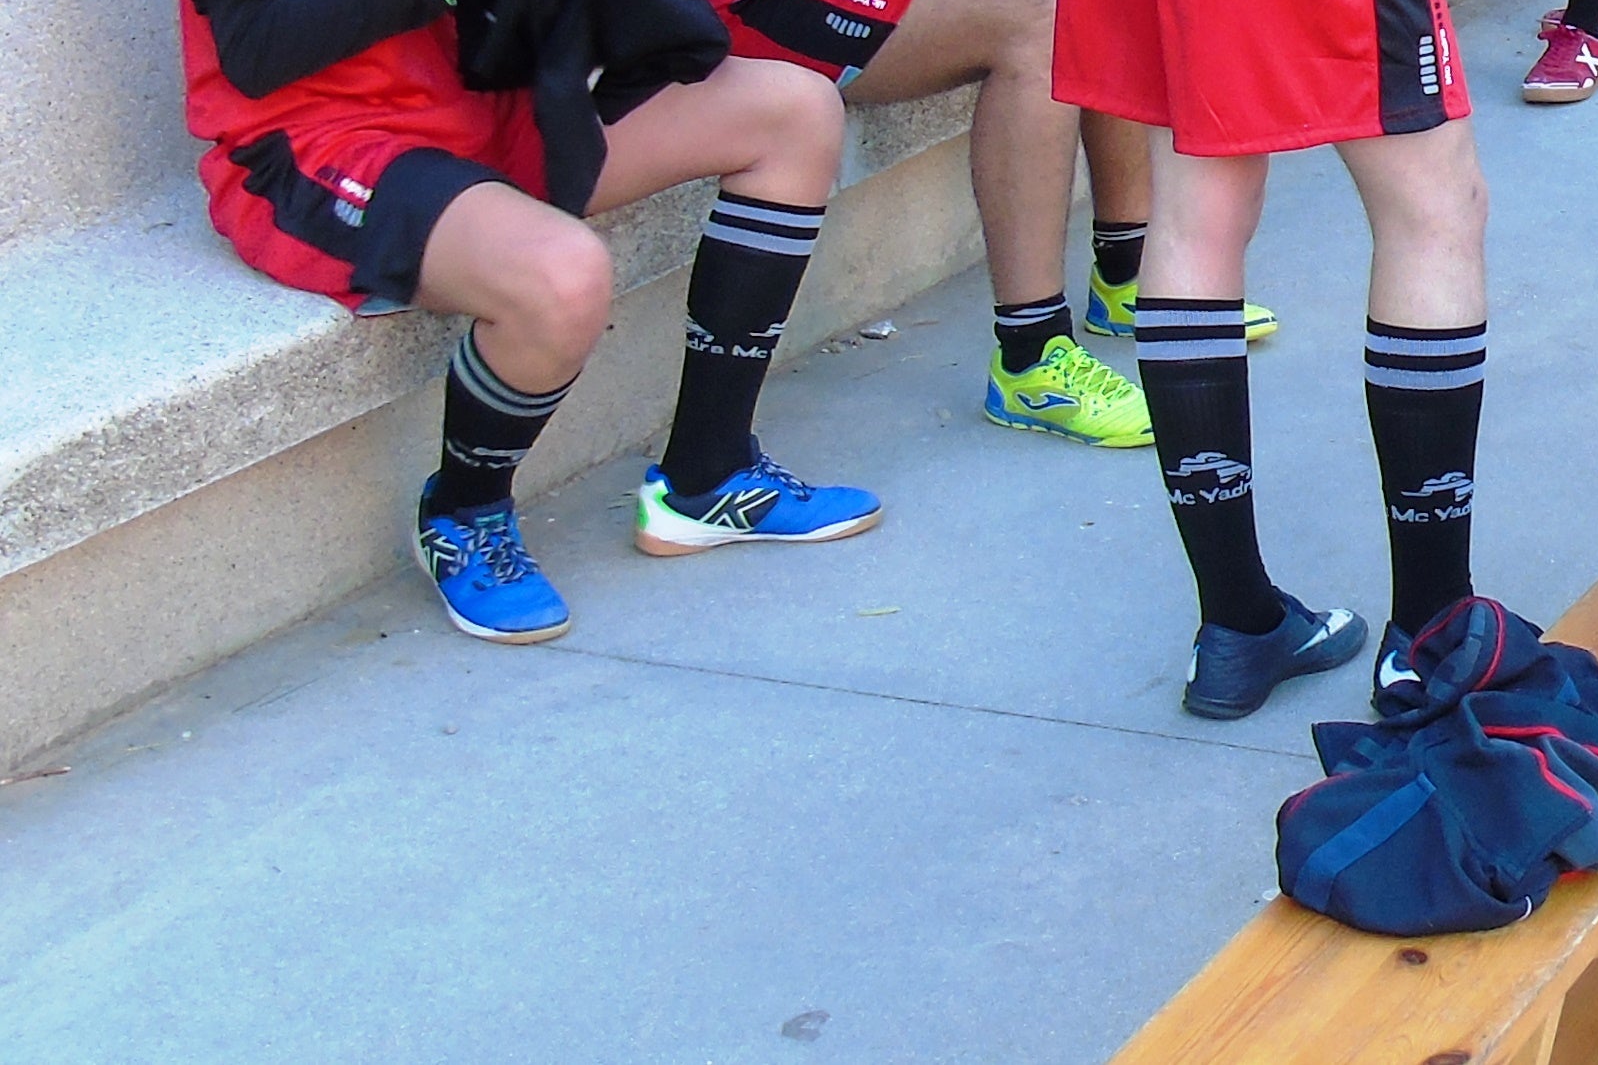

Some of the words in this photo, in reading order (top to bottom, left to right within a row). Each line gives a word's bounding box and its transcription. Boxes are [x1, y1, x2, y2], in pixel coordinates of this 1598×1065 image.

[1198, 479, 1254, 504] Yadr
[1390, 504, 1430, 523] Mc
[1434, 497, 1472, 522] Yad
